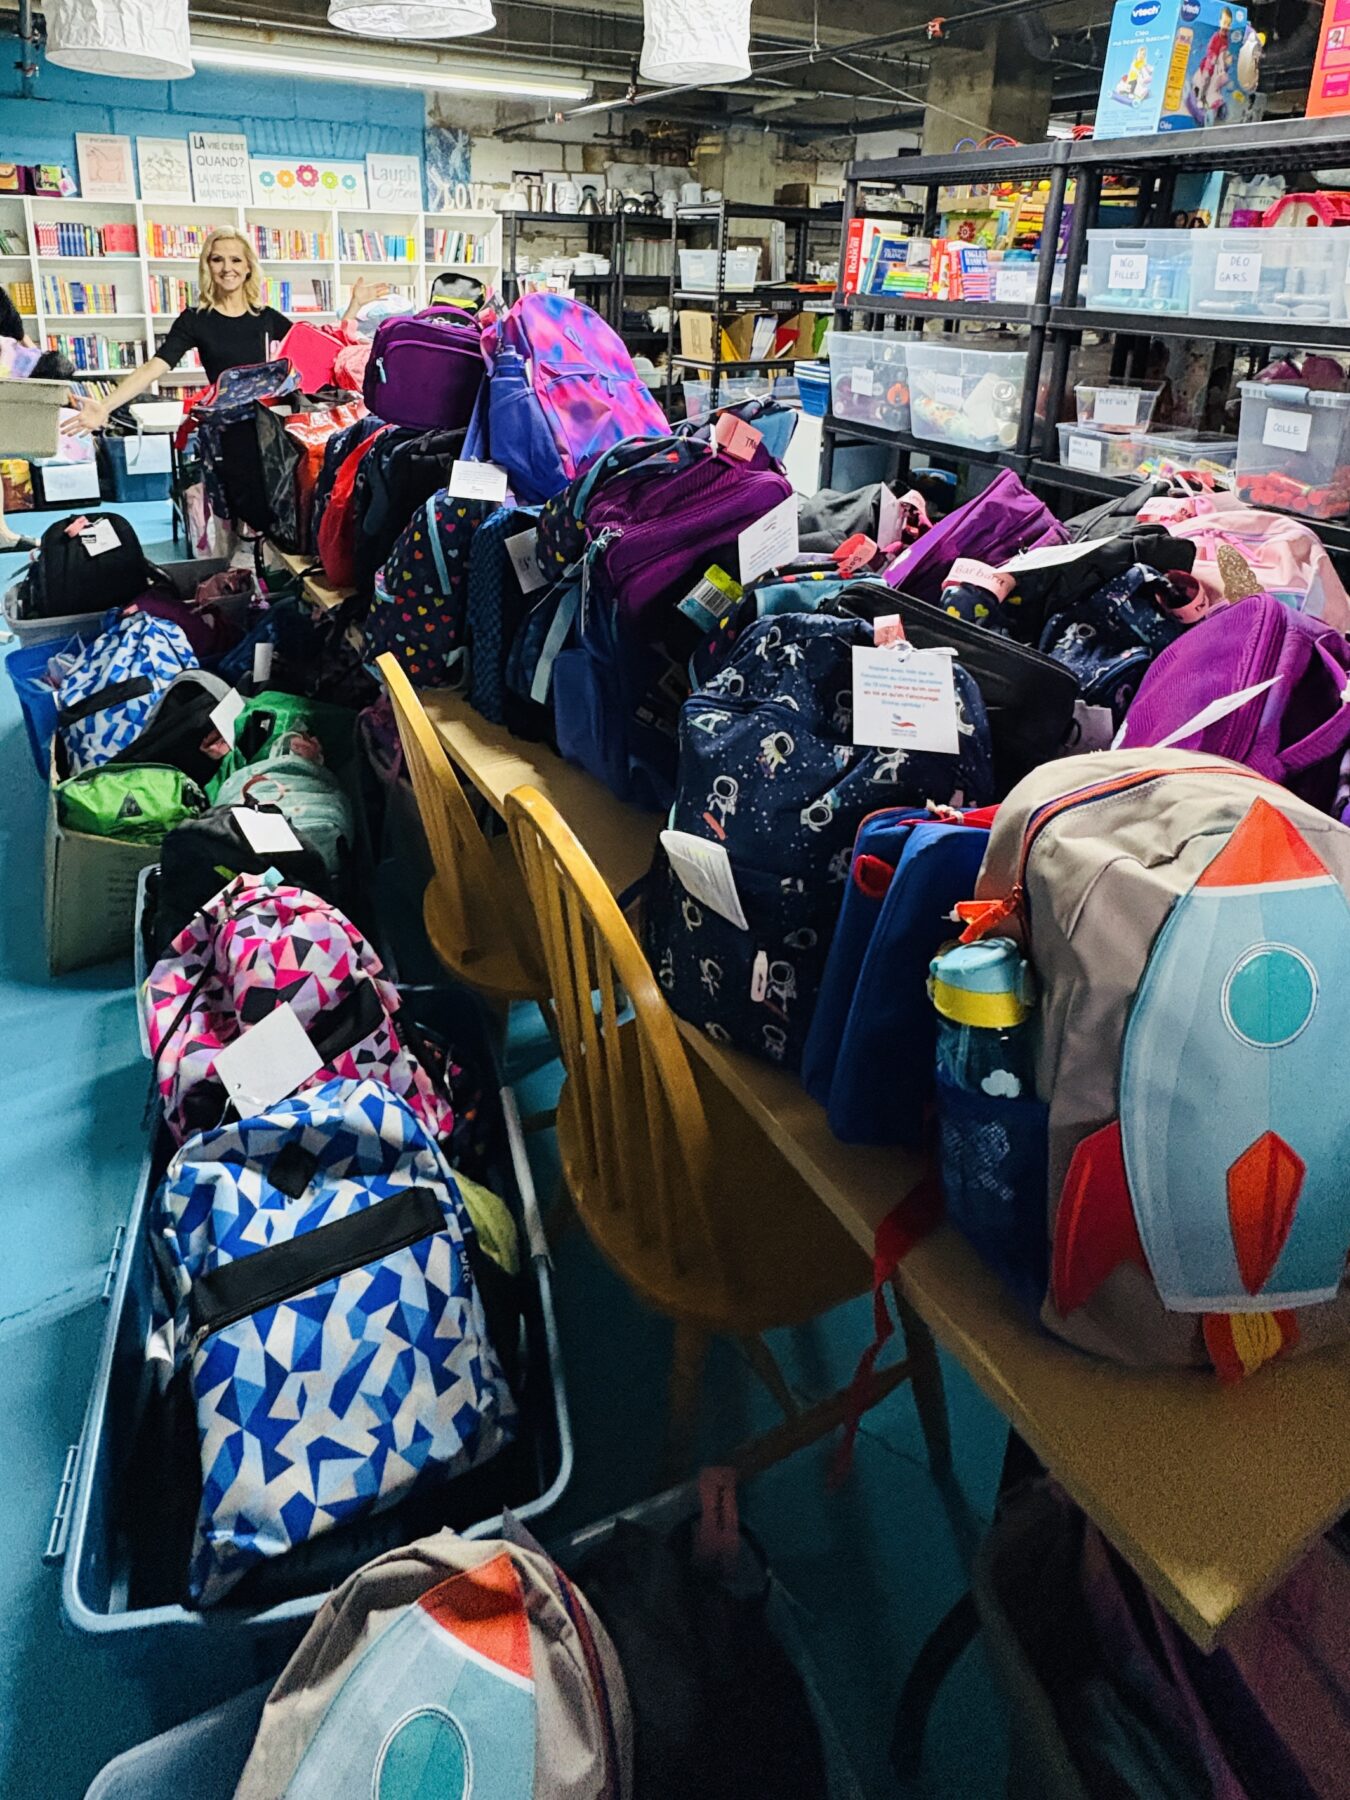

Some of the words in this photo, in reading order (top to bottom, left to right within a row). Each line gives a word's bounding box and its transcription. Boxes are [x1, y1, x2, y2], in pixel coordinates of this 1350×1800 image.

[1132, 5, 1160, 18] vtech
[193, 135, 205, 149] LA
[206, 142, 220, 150] VIE
[221, 143, 245, 151] C'EST
[196, 155, 245, 168] QUAND?
[371, 164, 417, 187] Laugh
[442, 182, 495, 210] LOVE
[847, 236, 860, 273] Robert
[1219, 271, 1248, 282] GARS
[1272, 422, 1301, 435] COLLE
